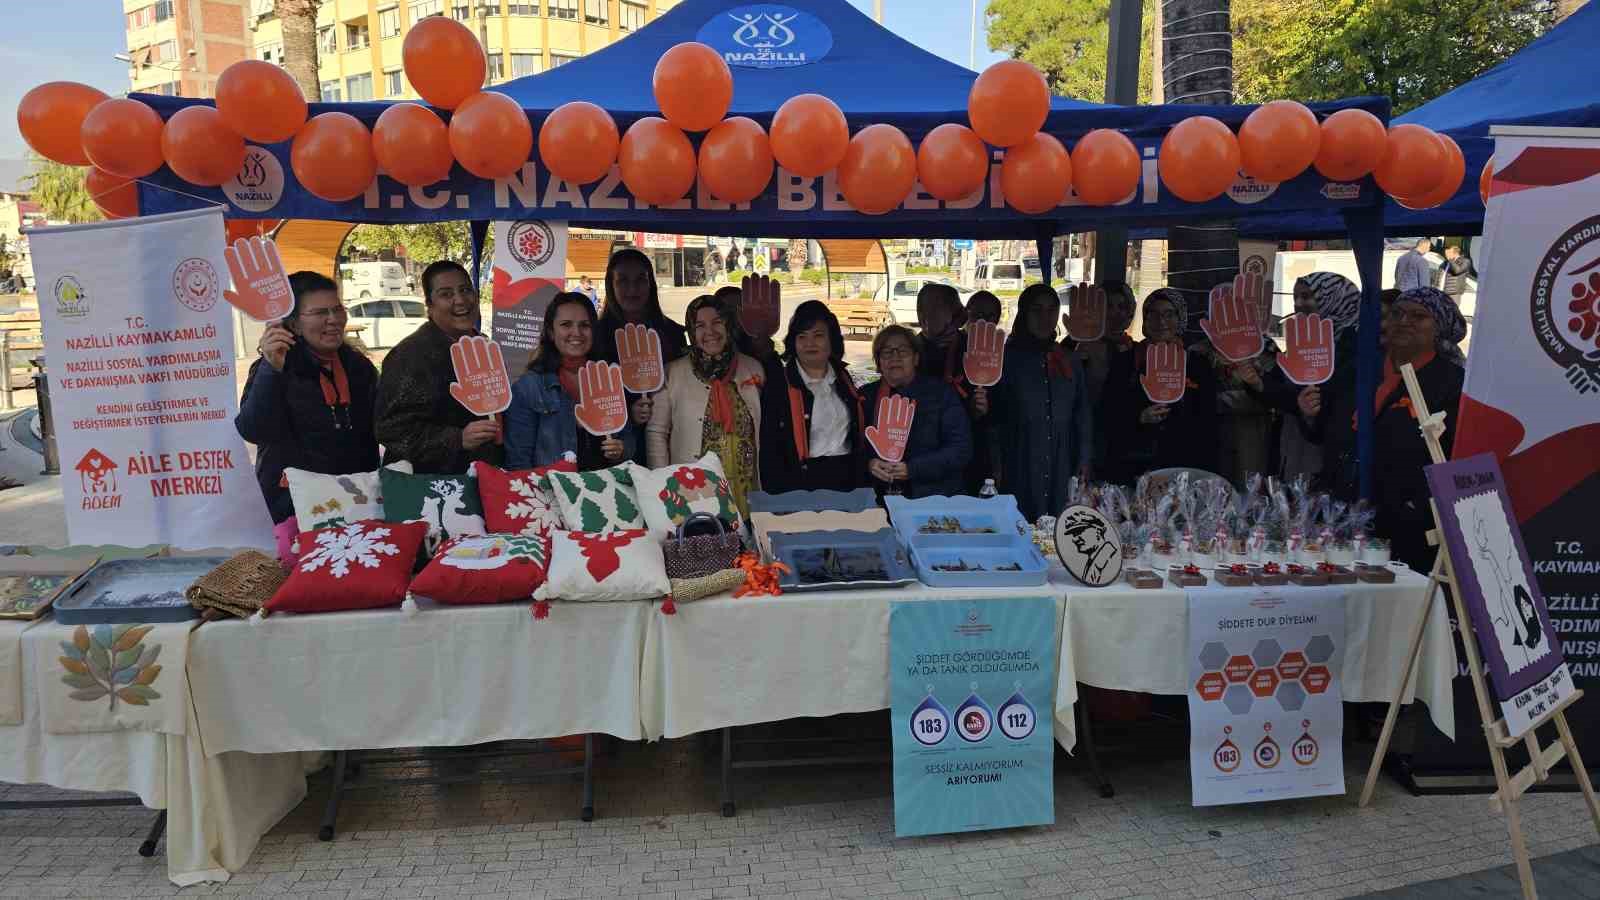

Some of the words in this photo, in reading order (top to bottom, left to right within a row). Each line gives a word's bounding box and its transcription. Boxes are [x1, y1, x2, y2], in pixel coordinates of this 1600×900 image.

[1536, 256, 1561, 305] SOSYAL
[125, 316, 149, 329] T.C.
[66, 333, 114, 350] NAZİLLİ
[116, 323, 217, 347] KAYMAKAMLIĞI
[107, 356, 145, 370] SOSYAL
[146, 350, 222, 368] YARDIMLAŞMA
[60, 379, 74, 389] VE
[76, 374, 136, 389] DAYANIŞMA
[138, 371, 170, 384] VAKFI
[128, 451, 174, 476] AİLE
[178, 449, 235, 471] DESTEK
[150, 472, 223, 498] MERKEZİ
[82, 495, 123, 510] ADEM
[1554, 541, 1584, 555] T.C.
[1257, 617, 1277, 627] DUR
[907, 666, 920, 676] YA
[922, 666, 938, 676] DA
[919, 718, 942, 734] 183
[1007, 713, 1028, 728] 112
[1218, 750, 1237, 762] 183
[1297, 744, 1314, 756] 112
